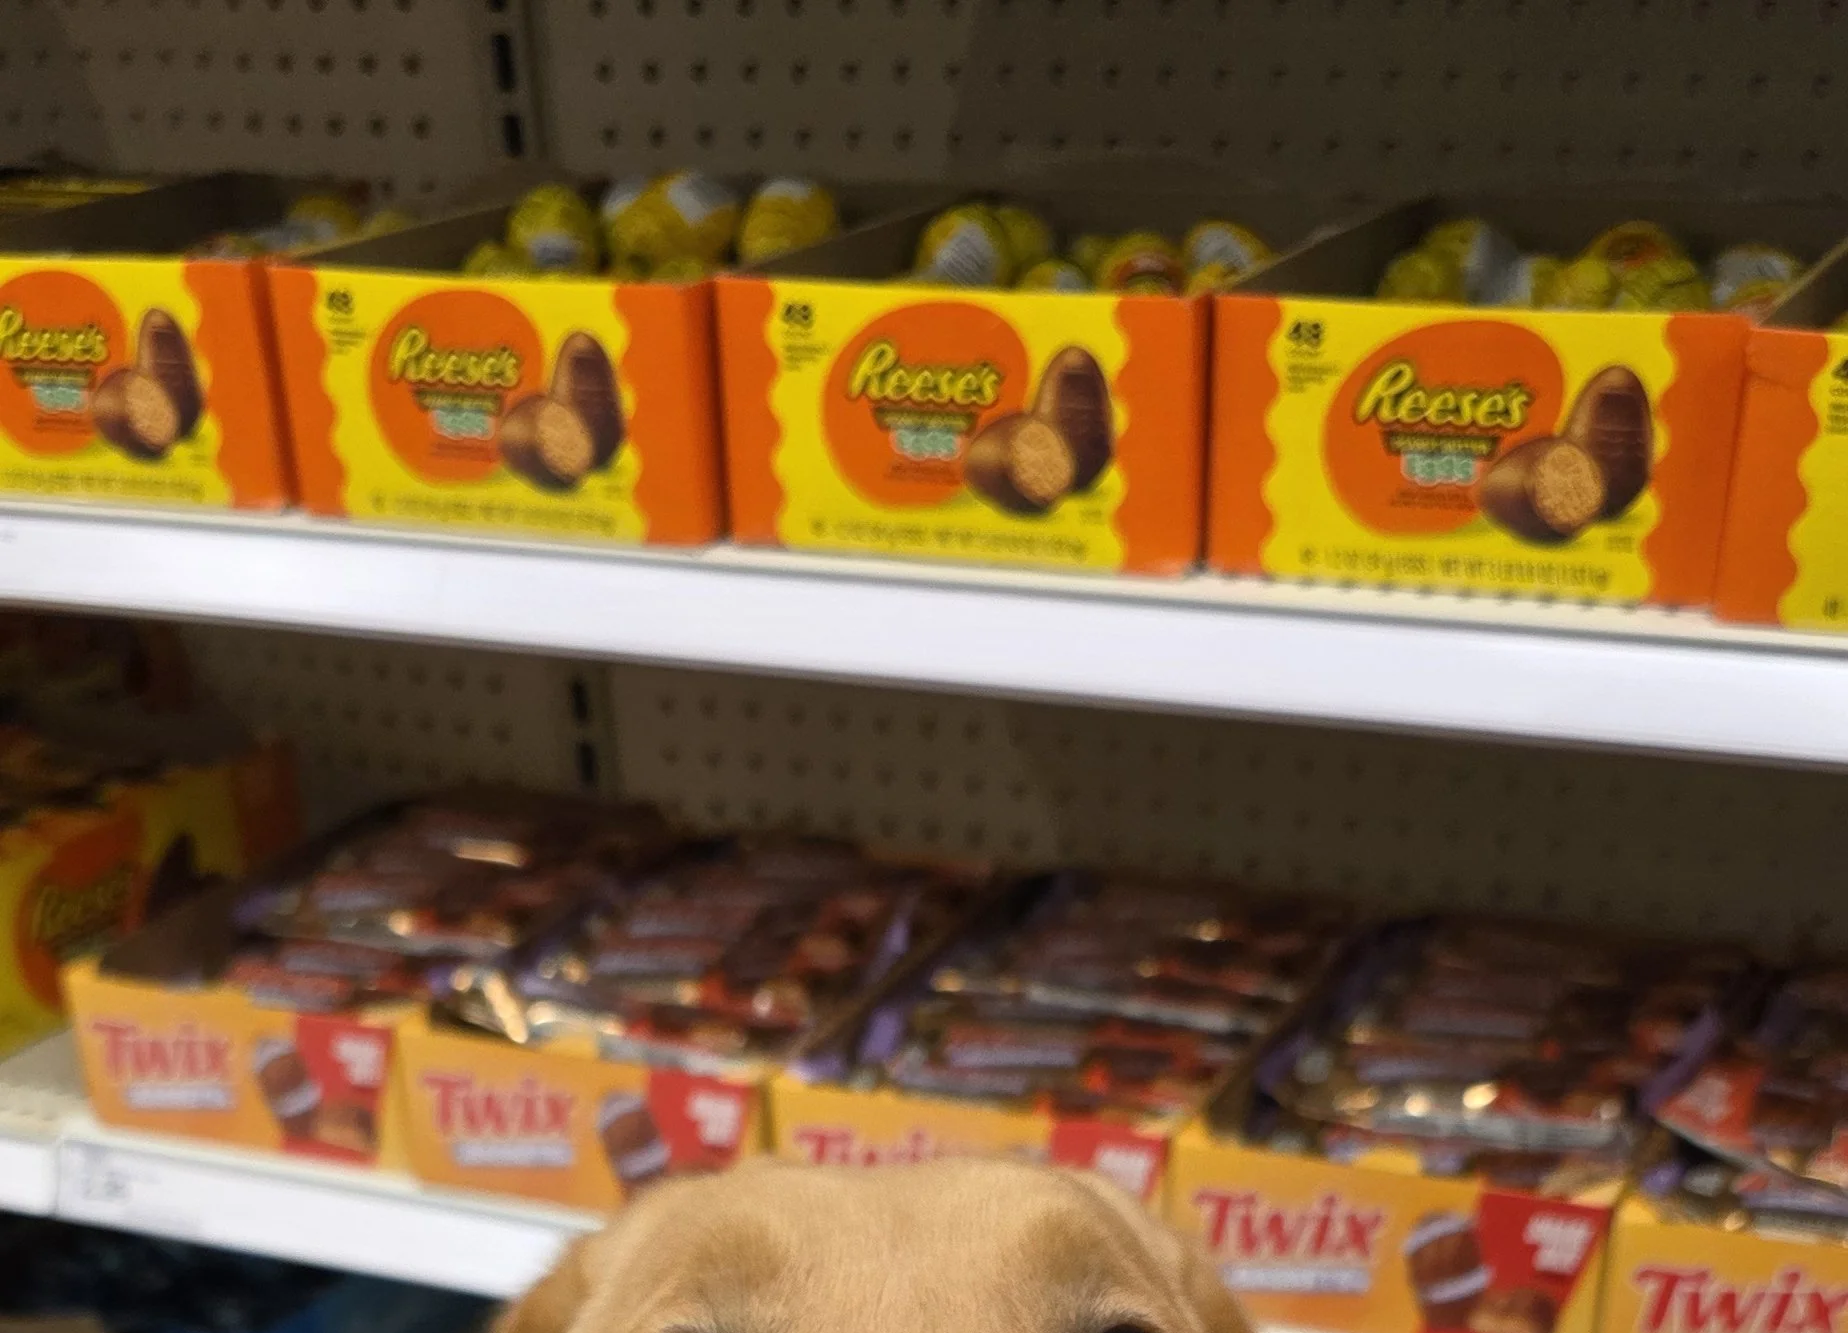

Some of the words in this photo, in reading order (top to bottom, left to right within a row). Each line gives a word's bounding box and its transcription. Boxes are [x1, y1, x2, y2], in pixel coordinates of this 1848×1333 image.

[388, 326, 519, 388] Reese's
[1288, 322, 1325, 346] 48
[850, 340, 1002, 407] Reese's
[1353, 362, 1531, 430] Reese's
[90, 1020, 231, 1077] Twix
[423, 1075, 575, 1135] Twix
[1195, 1192, 1383, 1256] Twix
